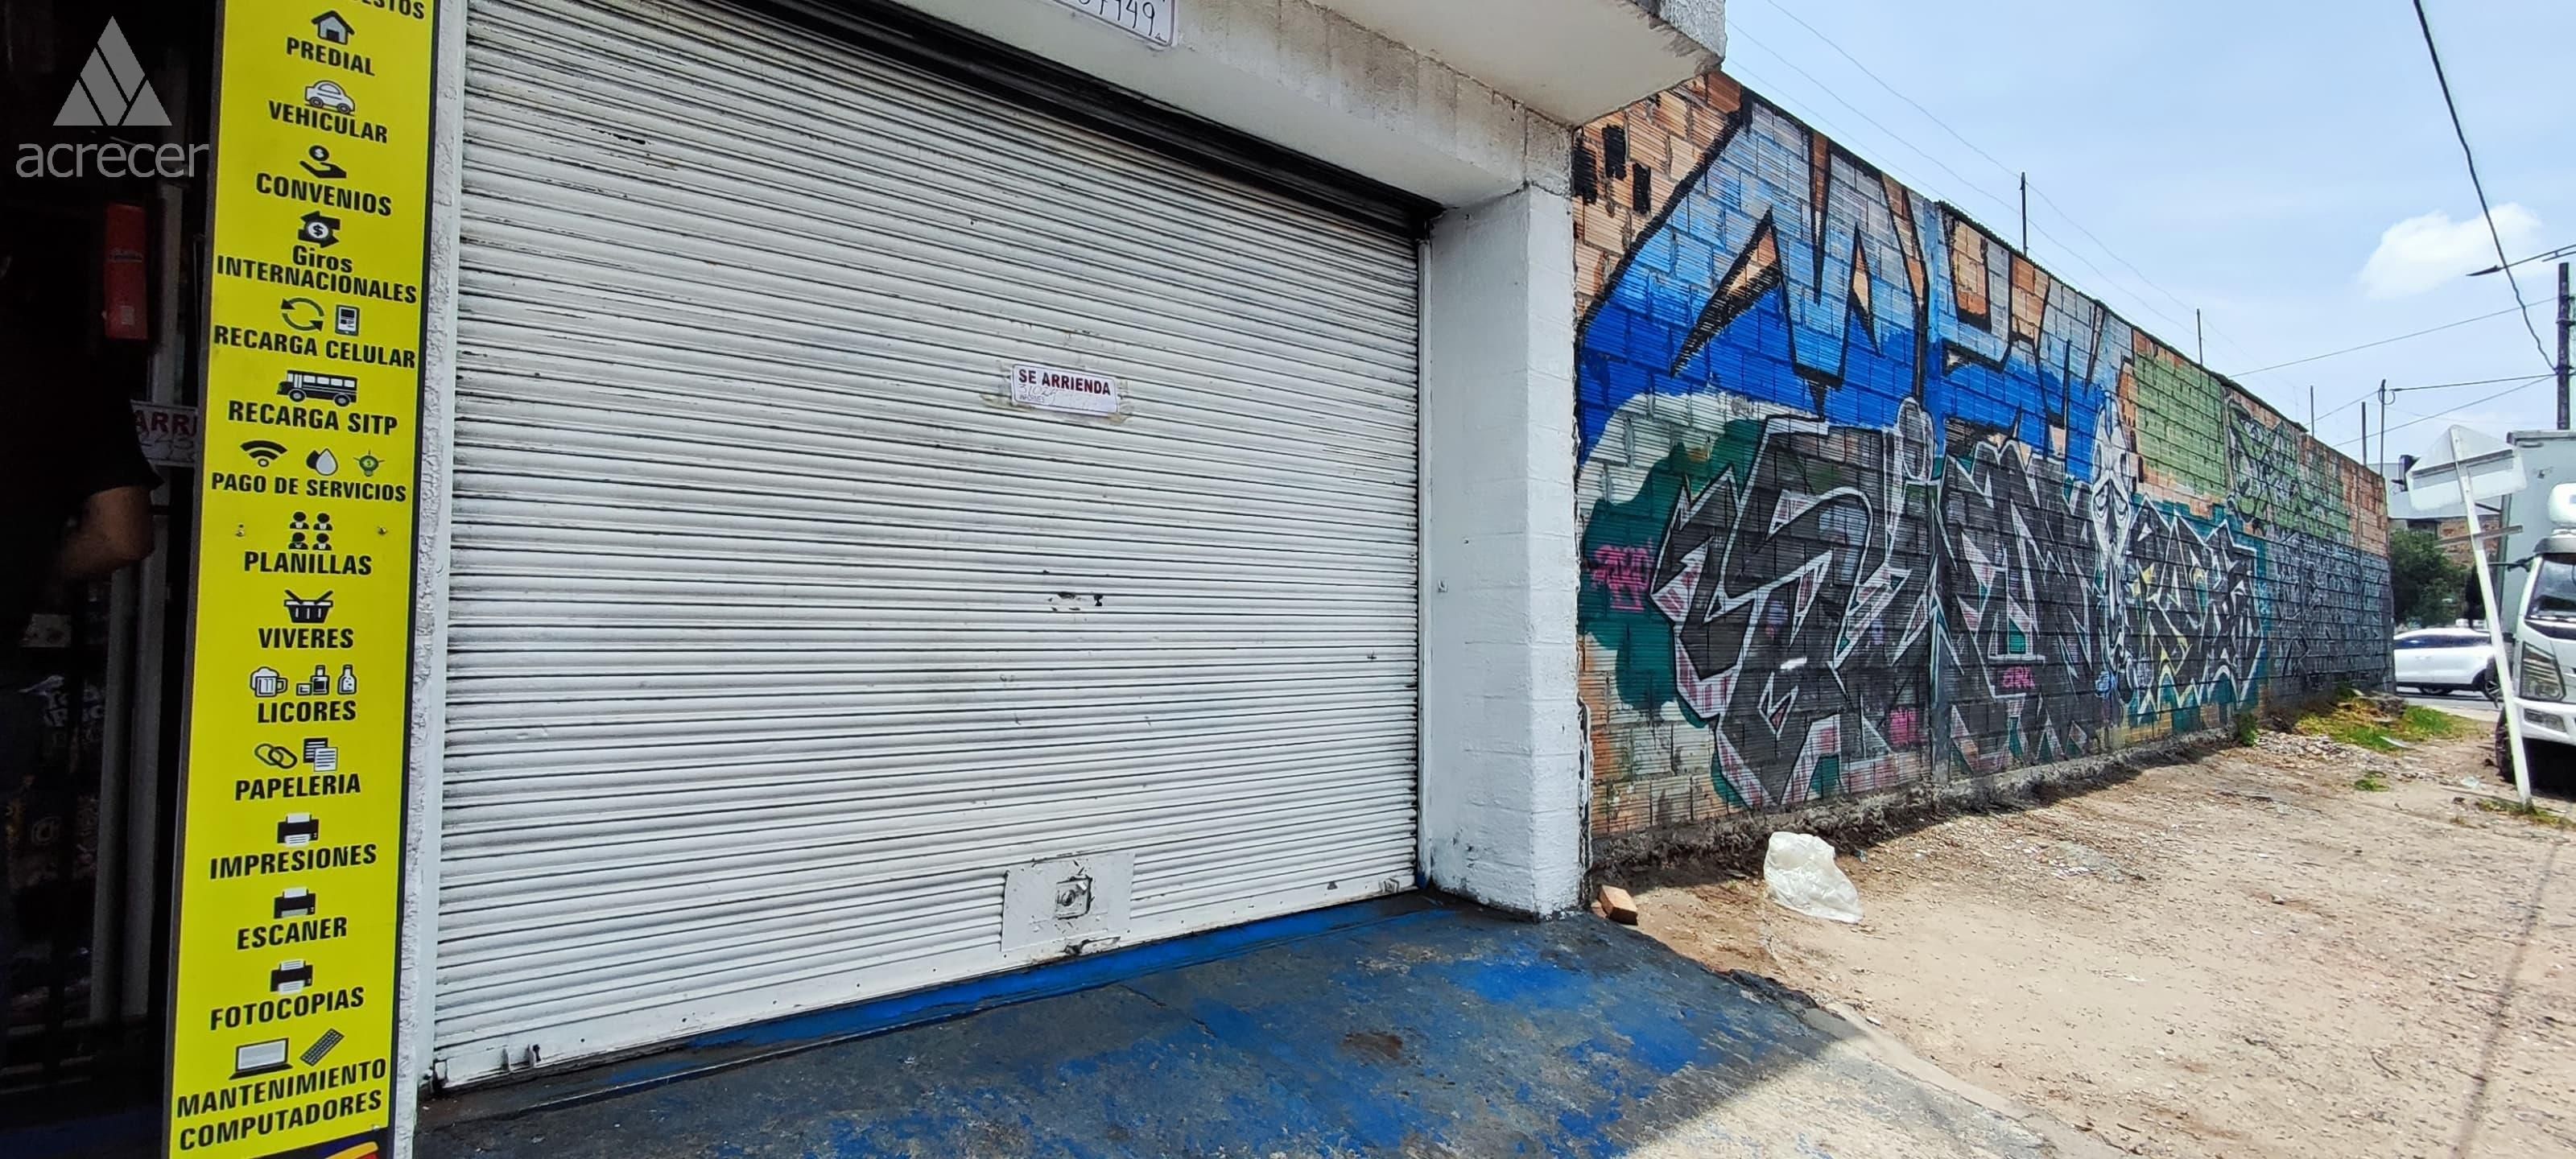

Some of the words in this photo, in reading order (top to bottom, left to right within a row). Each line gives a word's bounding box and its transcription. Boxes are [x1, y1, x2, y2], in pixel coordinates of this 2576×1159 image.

[287, 37, 375, 76] PREDIAL
[268, 101, 388, 143] VEHICULAR
[256, 173, 392, 217] CONVENIOS
[292, 245, 353, 274] Giros
[217, 255, 417, 304] INTERNACIONALES
[213, 325, 320, 357] RECARGA
[325, 340, 416, 369] CELULAR
[1018, 369, 1037, 384] SE
[1042, 373, 1111, 395] ARRIENDA
[229, 400, 340, 431] RECARGA
[347, 412, 398, 435] SITP
[211, 472, 267, 493] PAGO
[274, 476, 299, 495] DE
[305, 478, 407, 502] SERVICIOS
[244, 551, 373, 575] PLANILLAS
[258, 628, 354, 649] VIVERES
[257, 700, 357, 724] LICORES
[235, 773, 361, 801] PAPELERIA
[210, 843, 378, 880] IMPRESIONES
[237, 916, 348, 950] ESCANER
[210, 987, 365, 1031] FOTOCOPIAS
[177, 1058, 386, 1118] MANTENIMIENTO
[180, 1089, 382, 1150] COMPUTADORES
